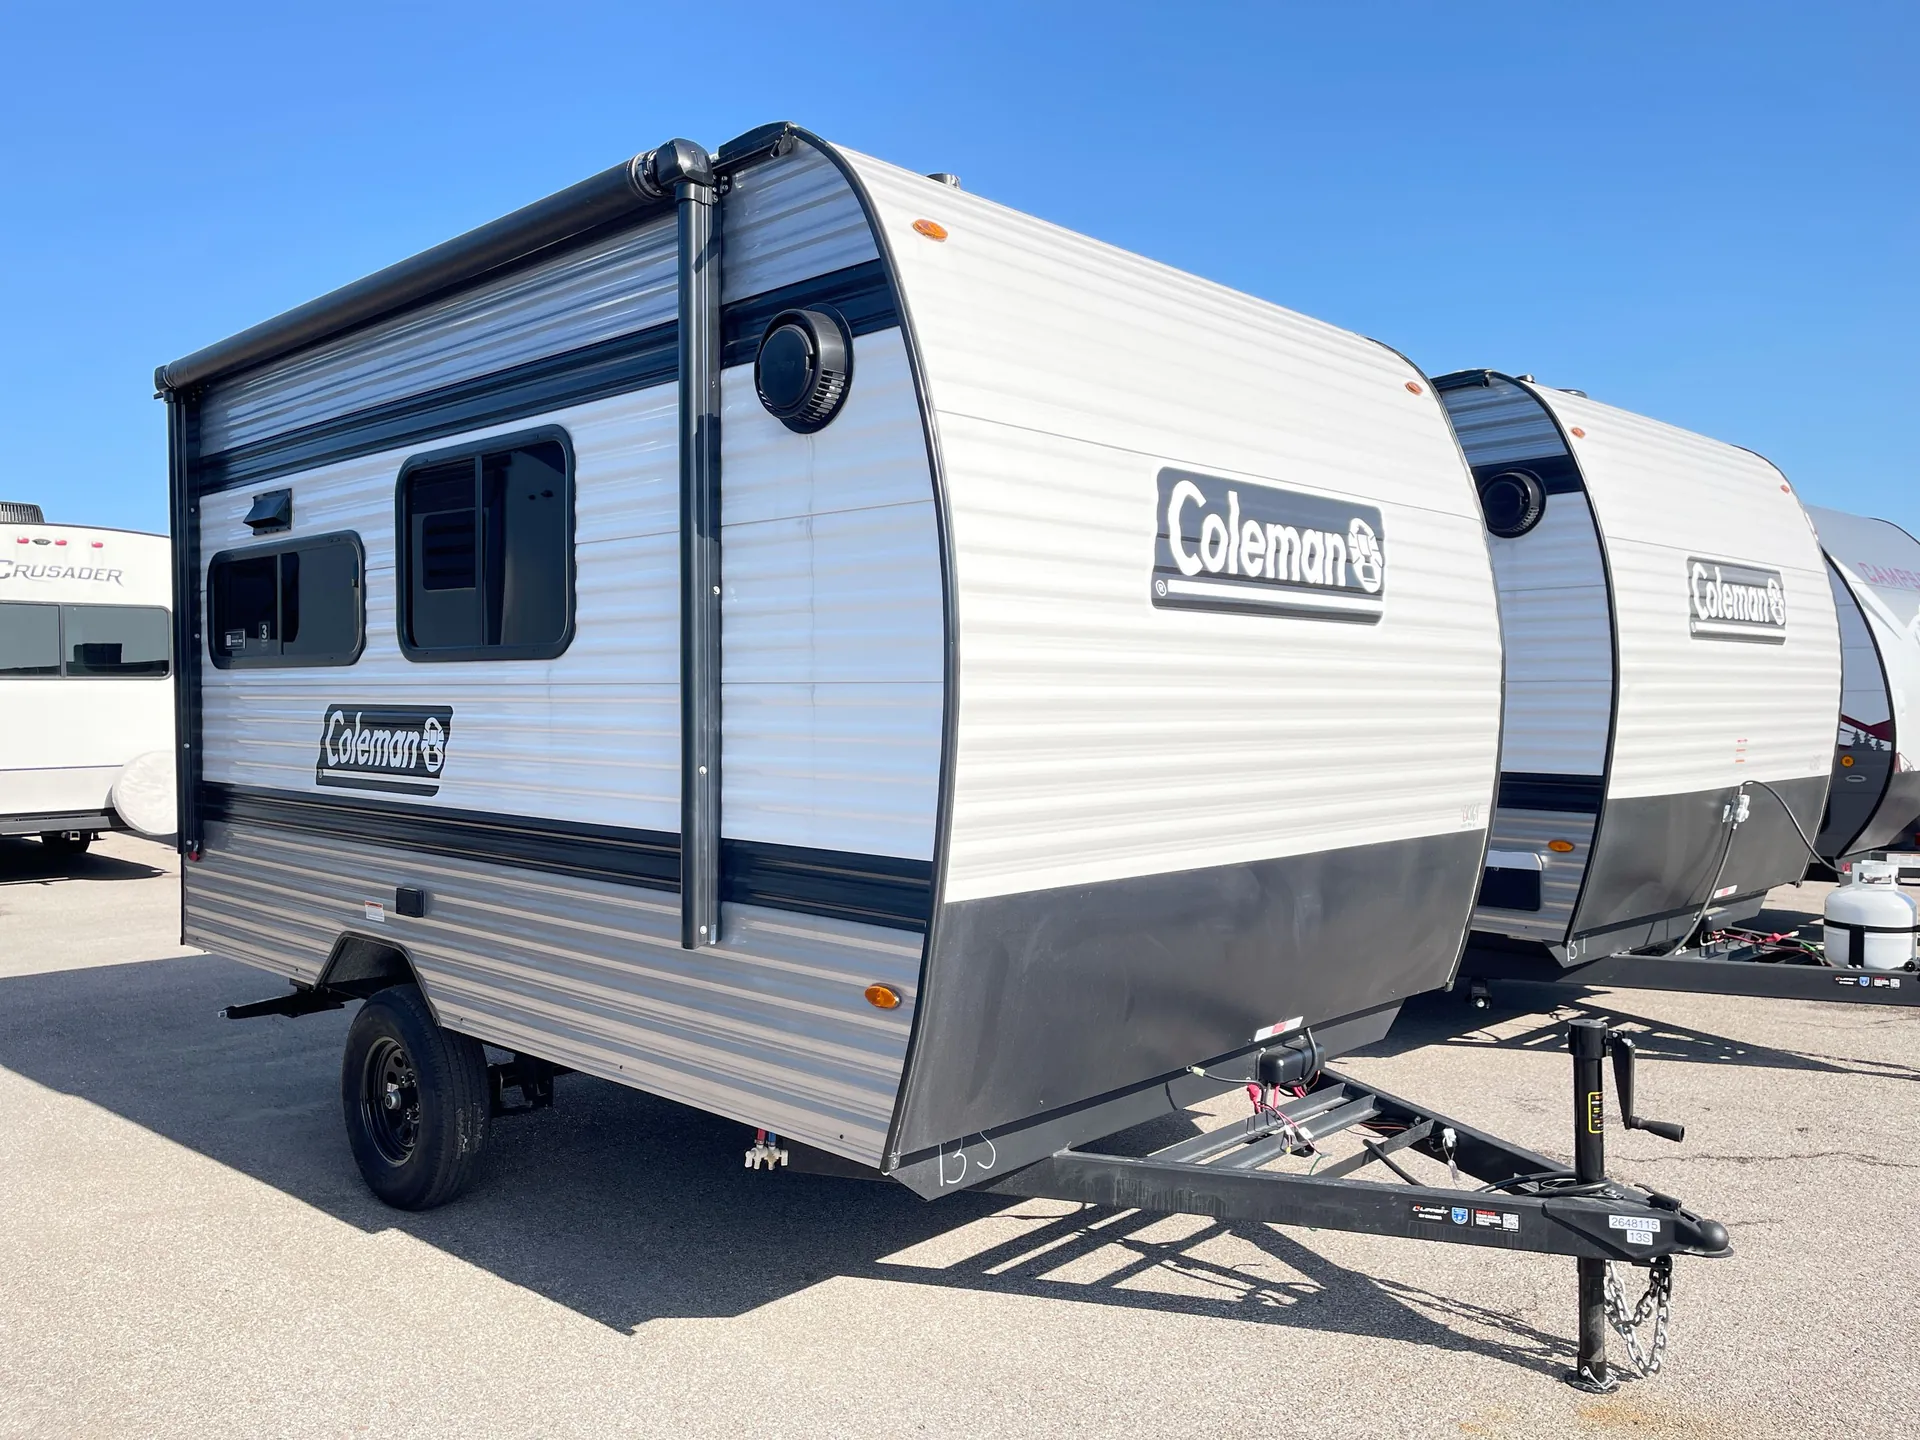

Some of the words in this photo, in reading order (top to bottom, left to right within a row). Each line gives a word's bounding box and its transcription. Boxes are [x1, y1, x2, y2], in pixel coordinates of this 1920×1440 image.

[1167, 479, 1348, 587] Coleman
[0, 560, 124, 587] CRUSADER
[1692, 562, 1770, 622] Coleman
[261, 624, 268, 639] 3
[325, 709, 421, 769] Coleman
[1611, 1216, 1658, 1230] 2648115
[1630, 1232, 1651, 1243] 13S
